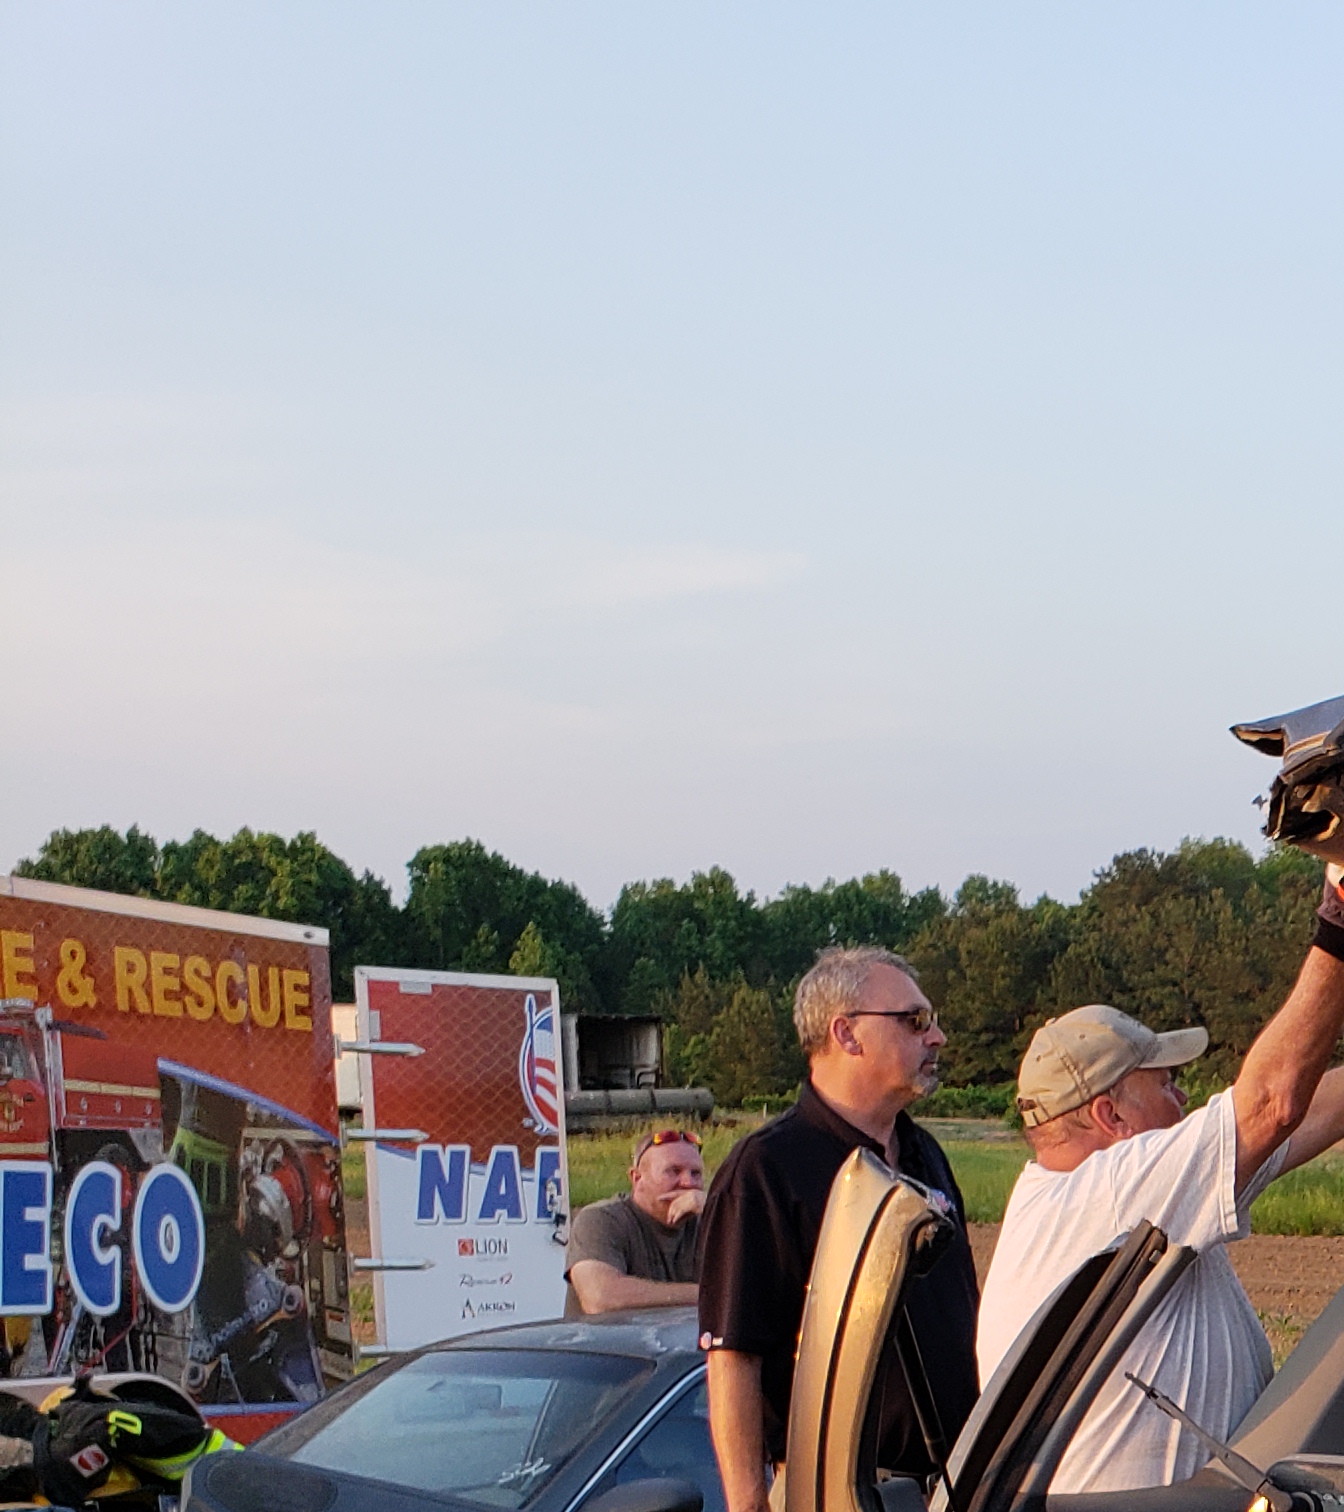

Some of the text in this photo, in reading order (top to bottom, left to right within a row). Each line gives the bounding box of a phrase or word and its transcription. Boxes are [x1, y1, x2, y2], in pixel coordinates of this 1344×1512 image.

[57, 938, 97, 1008] &
[113, 945, 313, 1032] RESCUE
[0, 1160, 205, 1316] ECO
[475, 1238, 508, 1255] LION
